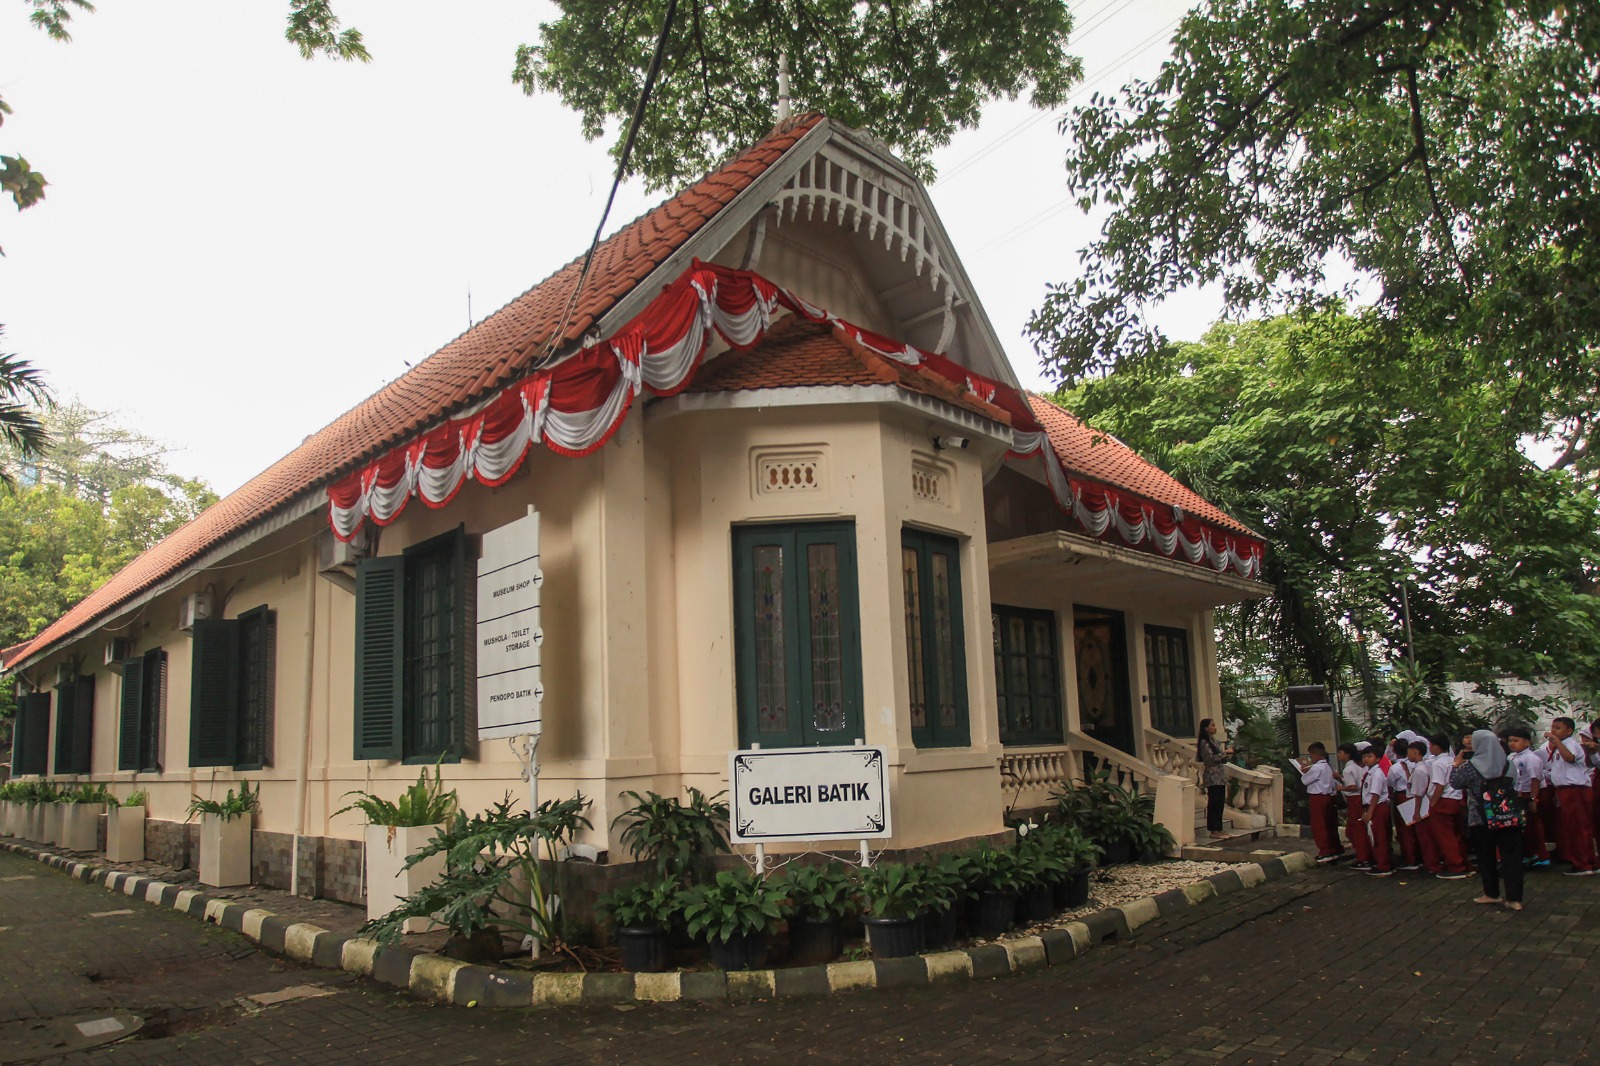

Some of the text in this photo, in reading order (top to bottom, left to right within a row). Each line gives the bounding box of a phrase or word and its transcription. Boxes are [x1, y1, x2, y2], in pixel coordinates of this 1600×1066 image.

[493, 579, 530, 598] MUSEUM SHOP
[484, 634, 508, 646] MUSHOLA
[511, 627, 530, 638] TOILET
[505, 640, 530, 652] STORAGE
[490, 689, 531, 702] PENDOPO BATIK
[749, 783, 870, 806] GALERI BATIK
